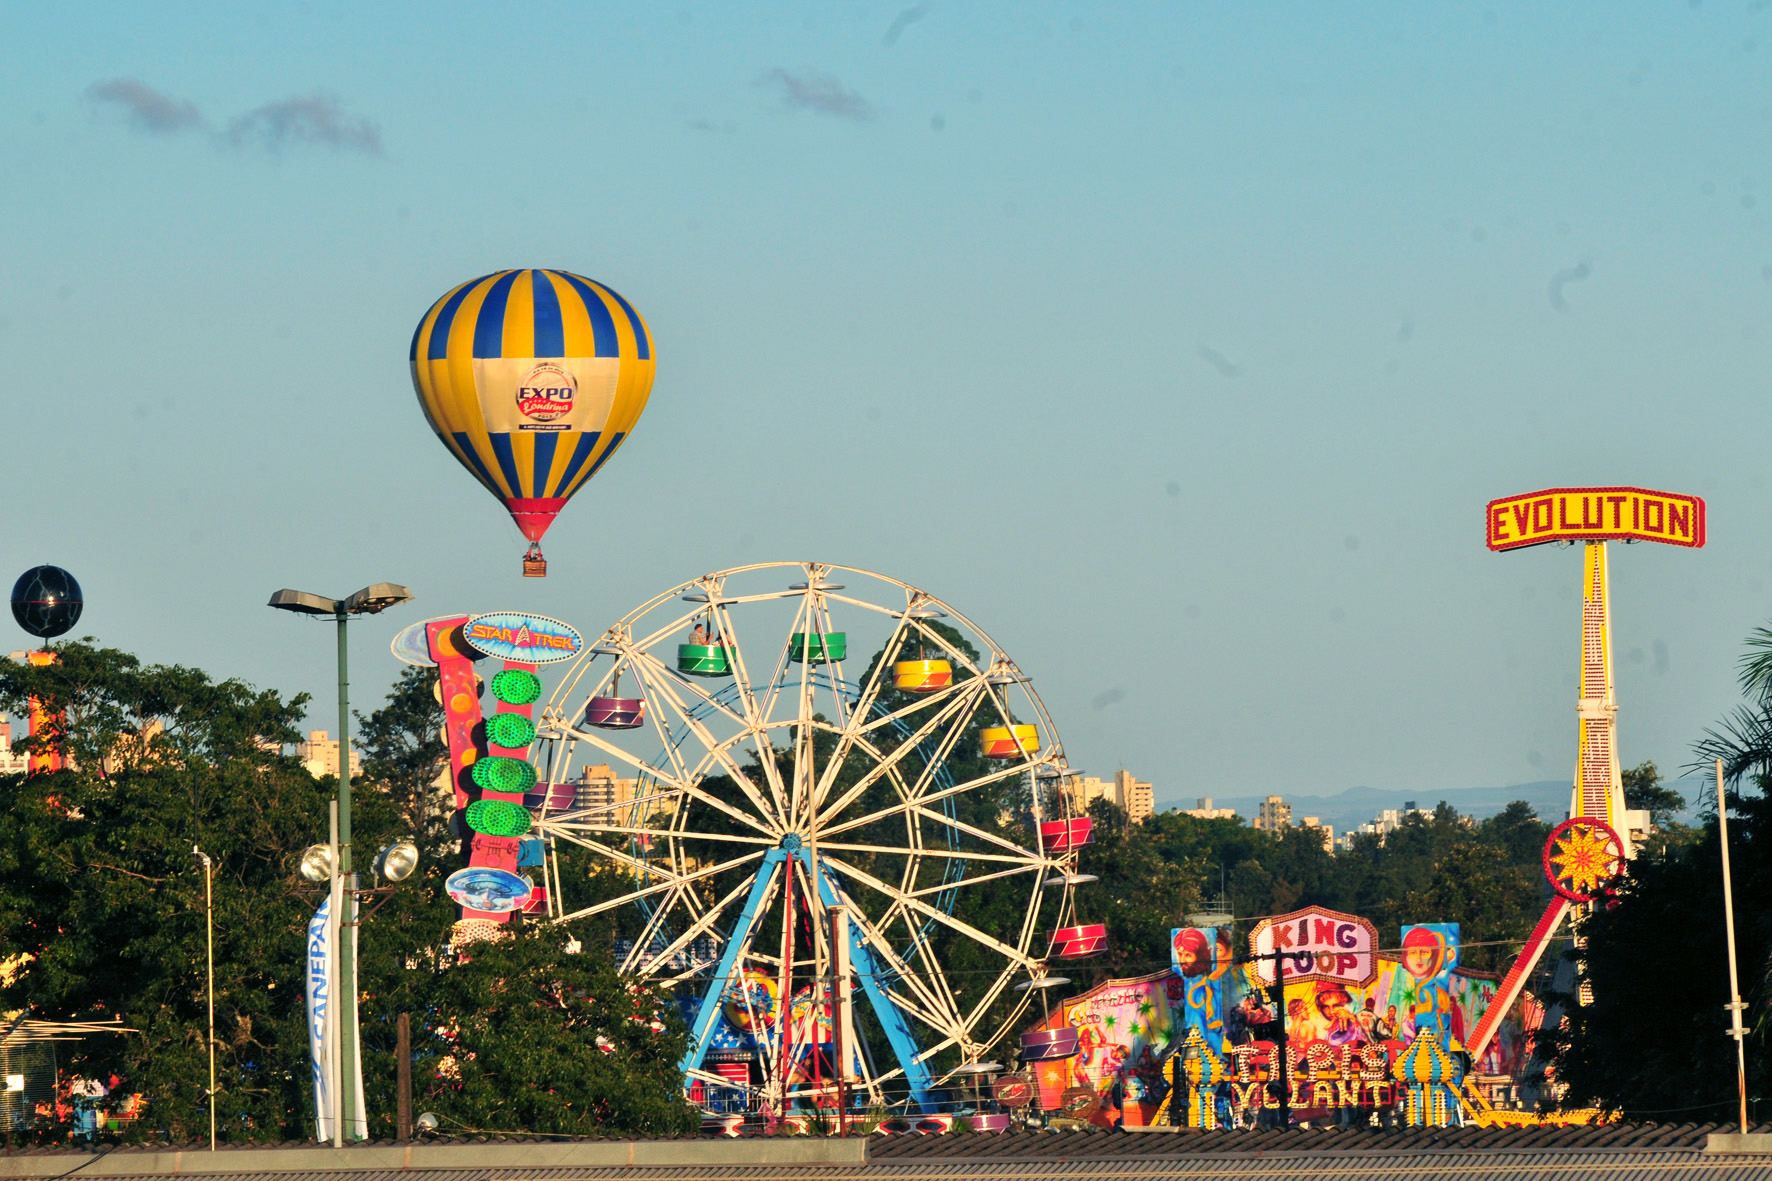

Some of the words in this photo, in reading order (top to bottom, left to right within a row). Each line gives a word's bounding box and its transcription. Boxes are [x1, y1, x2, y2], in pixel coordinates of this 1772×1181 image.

[519, 387, 573, 400] EXPO
[523, 402, 569, 414] Londrina
[1492, 496, 1690, 542] EVOLUTION
[470, 624, 513, 642] STAR
[533, 633, 576, 650] TREK
[1271, 918, 1357, 950] KING
[1231, 1043, 1388, 1083] TAPIS
[1231, 1080, 1390, 1110] VOLANT
